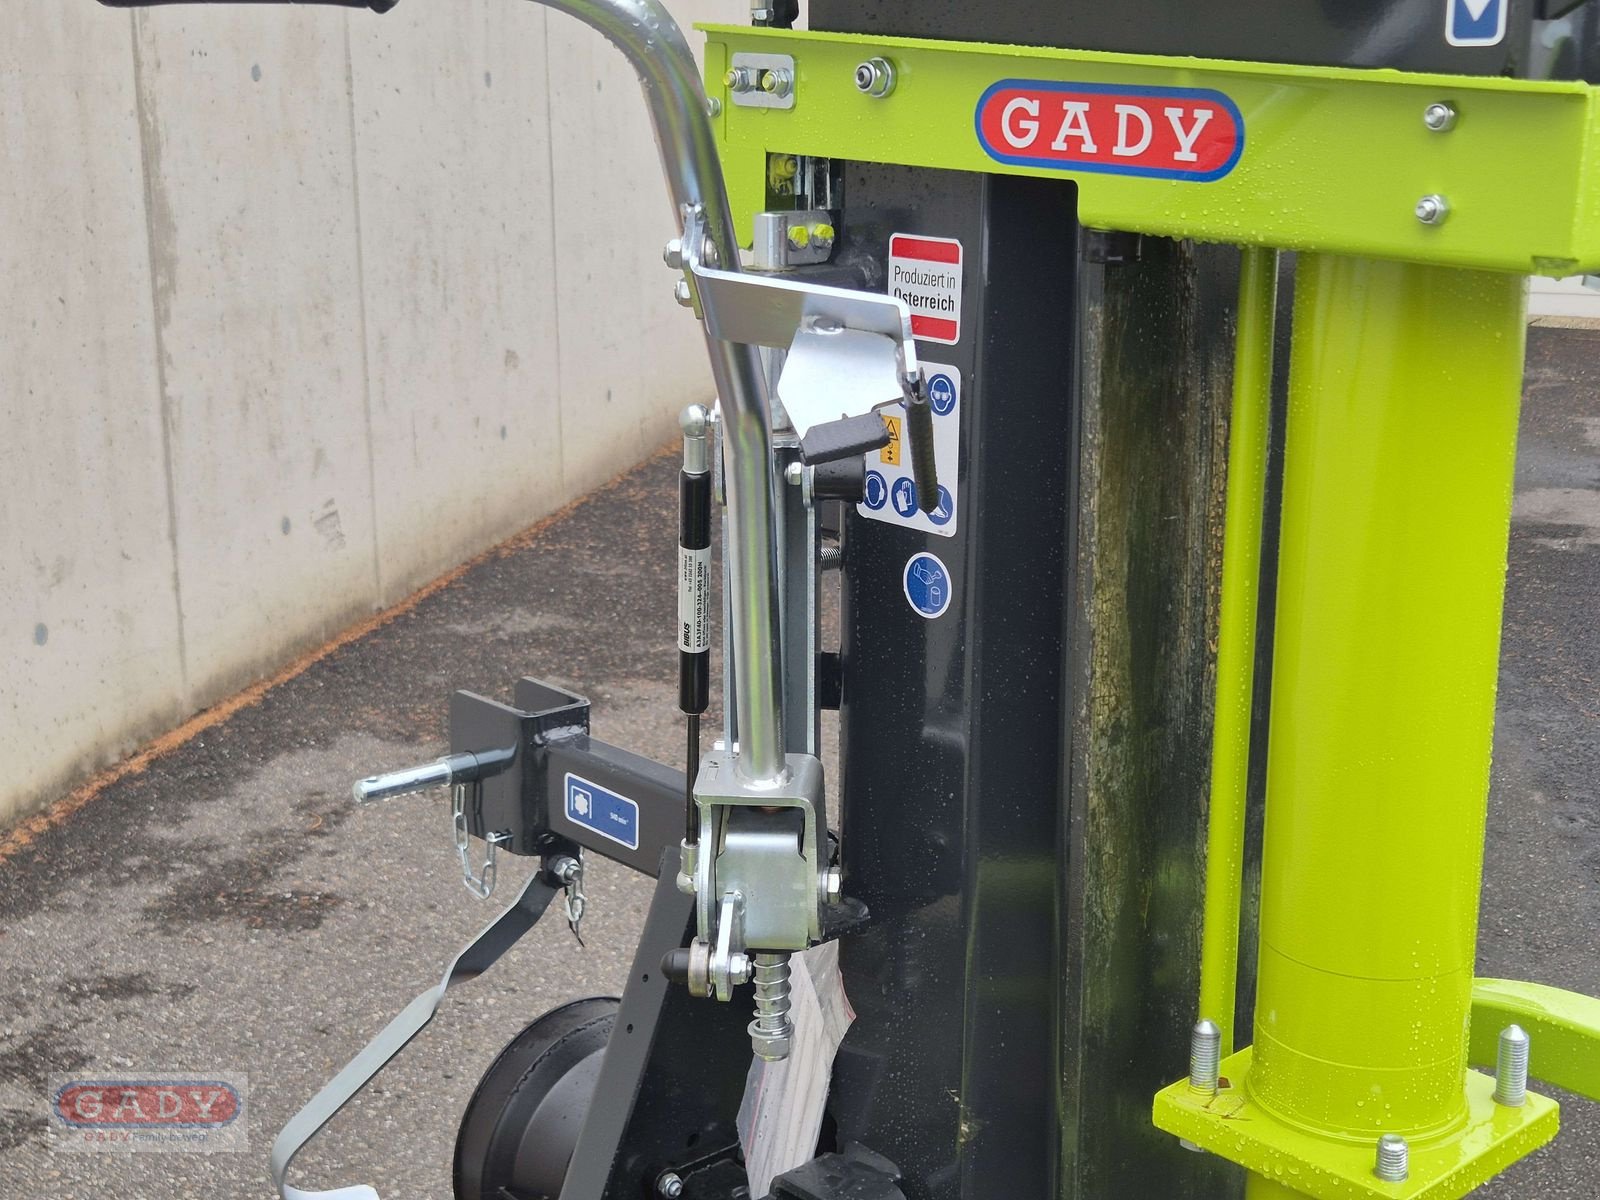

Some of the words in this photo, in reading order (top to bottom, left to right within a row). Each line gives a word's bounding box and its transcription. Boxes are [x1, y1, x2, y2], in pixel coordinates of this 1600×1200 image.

[1001, 97, 1213, 162] GADY
[894, 265, 945, 288] Produziert
[946, 272, 956, 289] in
